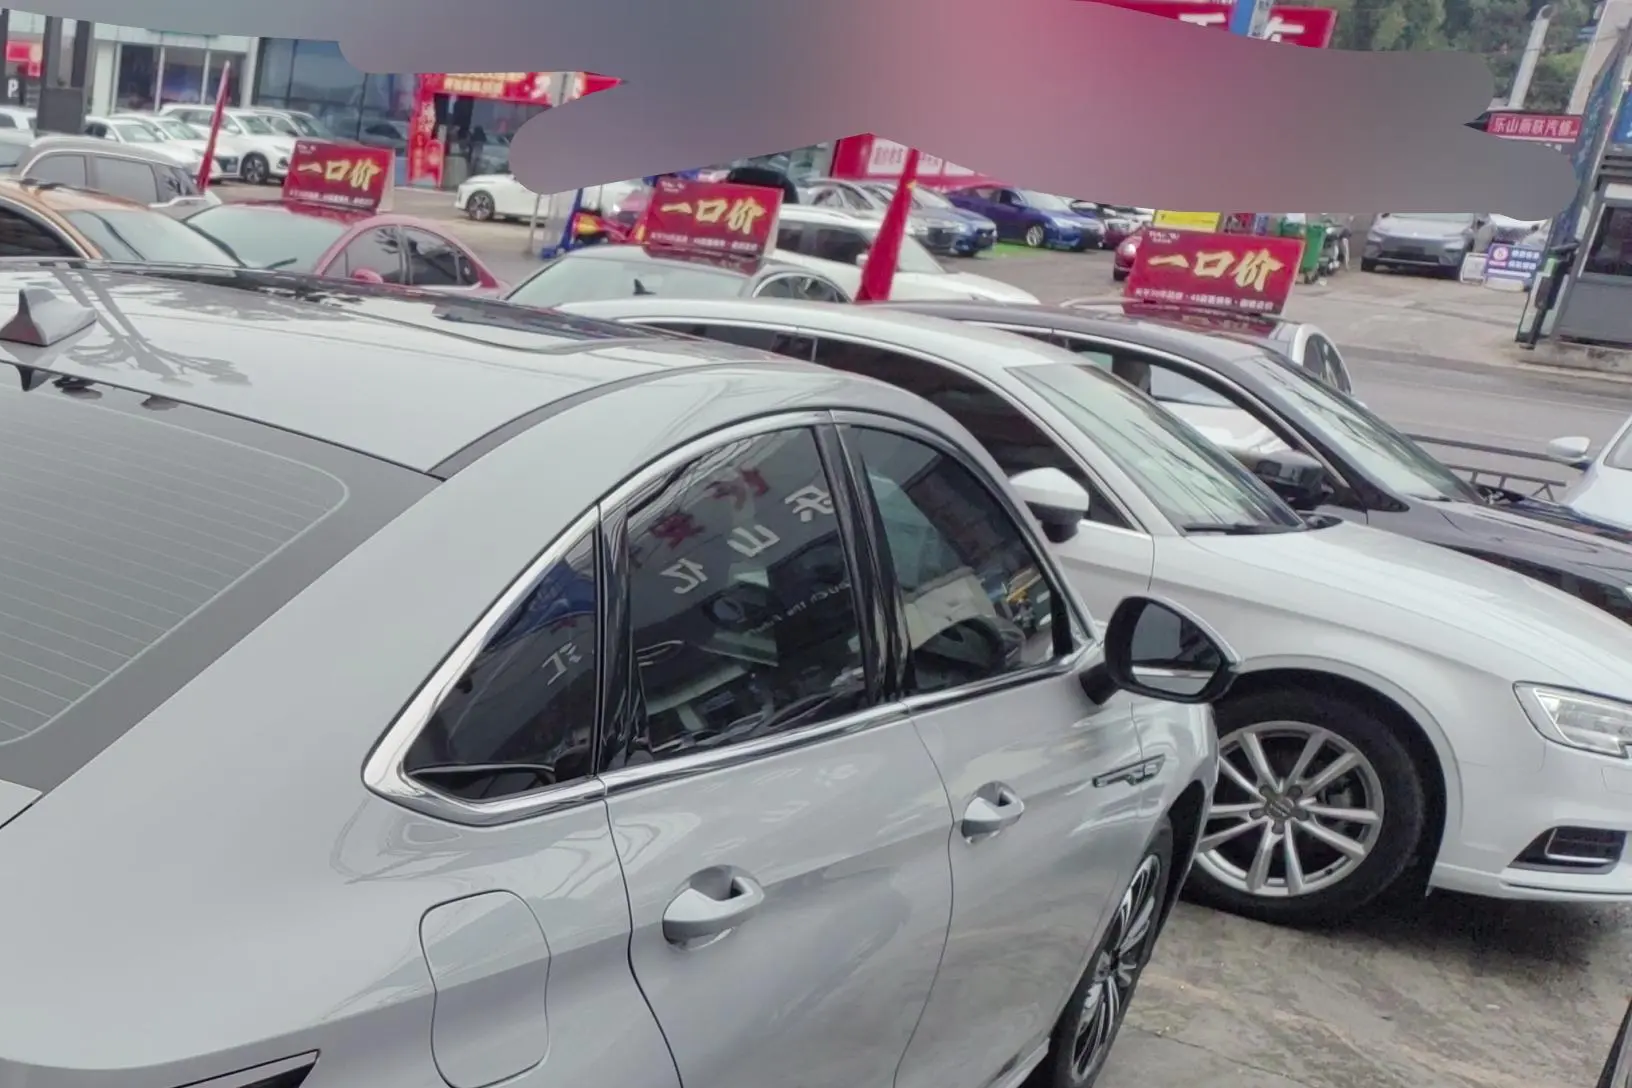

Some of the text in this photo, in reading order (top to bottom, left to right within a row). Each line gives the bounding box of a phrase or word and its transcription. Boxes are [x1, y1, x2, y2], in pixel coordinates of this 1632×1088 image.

[297, 158, 382, 192] 一口价
[660, 196, 767, 235] 一口价
[1147, 247, 1285, 292] 一口价
